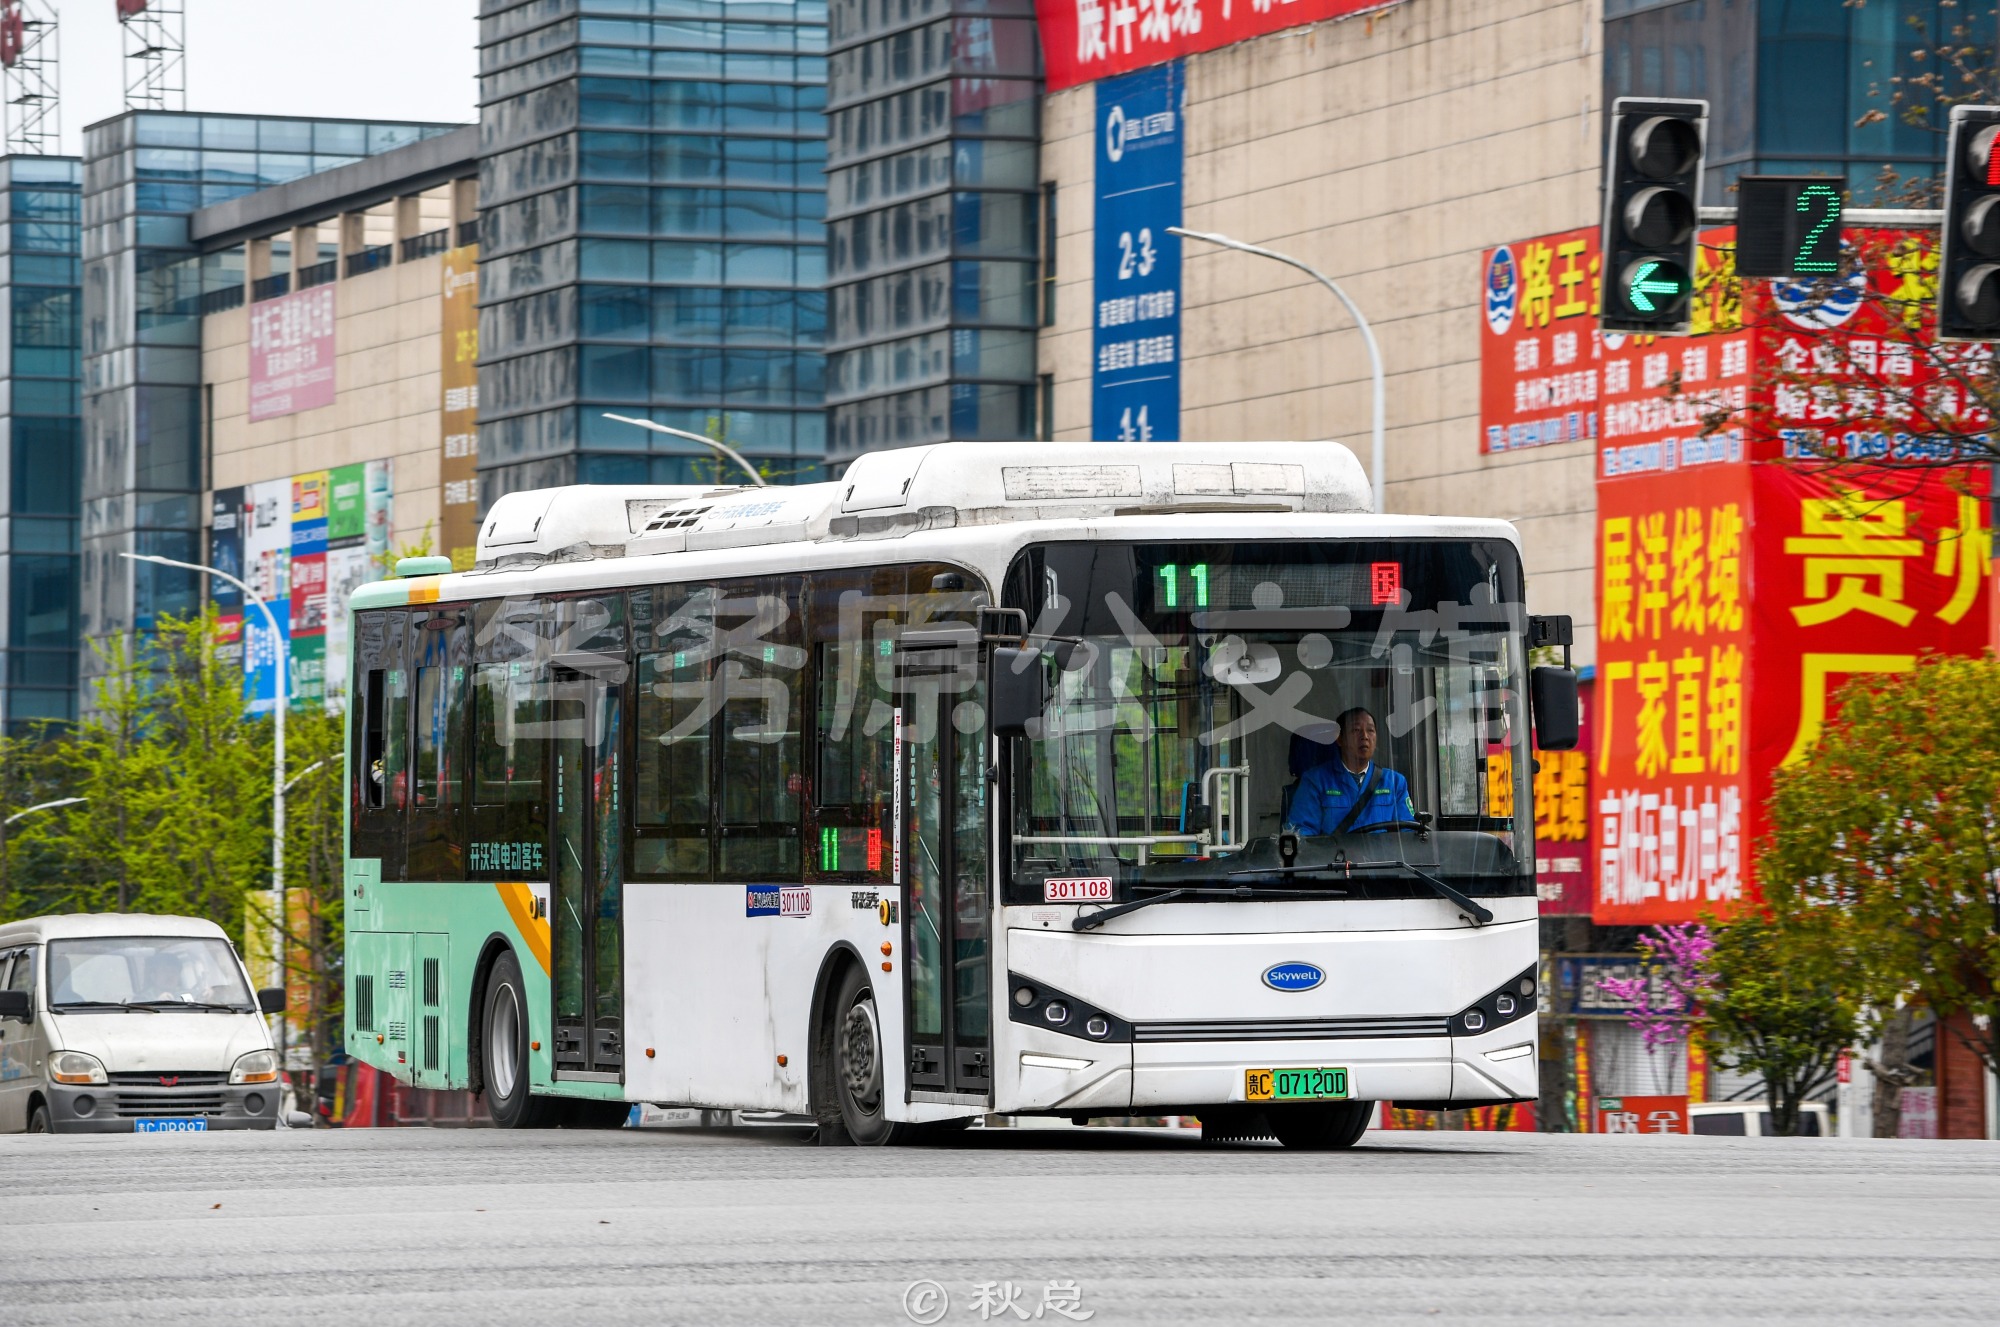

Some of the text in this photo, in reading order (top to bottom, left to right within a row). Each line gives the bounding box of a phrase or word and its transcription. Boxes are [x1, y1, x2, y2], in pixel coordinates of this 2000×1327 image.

[1794, 186, 1841, 272] 2
[1519, 239, 1600, 328] 将王
[1160, 564, 1207, 607] 11
[1600, 503, 1743, 642] 展洋线缆
[1600, 643, 1743, 779] 厂家直销
[470, 842, 543, 871] 开沃纯电动客车
[822, 827, 839, 871] 11
[1600, 785, 1743, 906] 高低压电力电缆
[781, 891, 810, 913] 301108
[1049, 881, 1108, 898] 301108
[1270, 971, 1319, 982] Skywell
